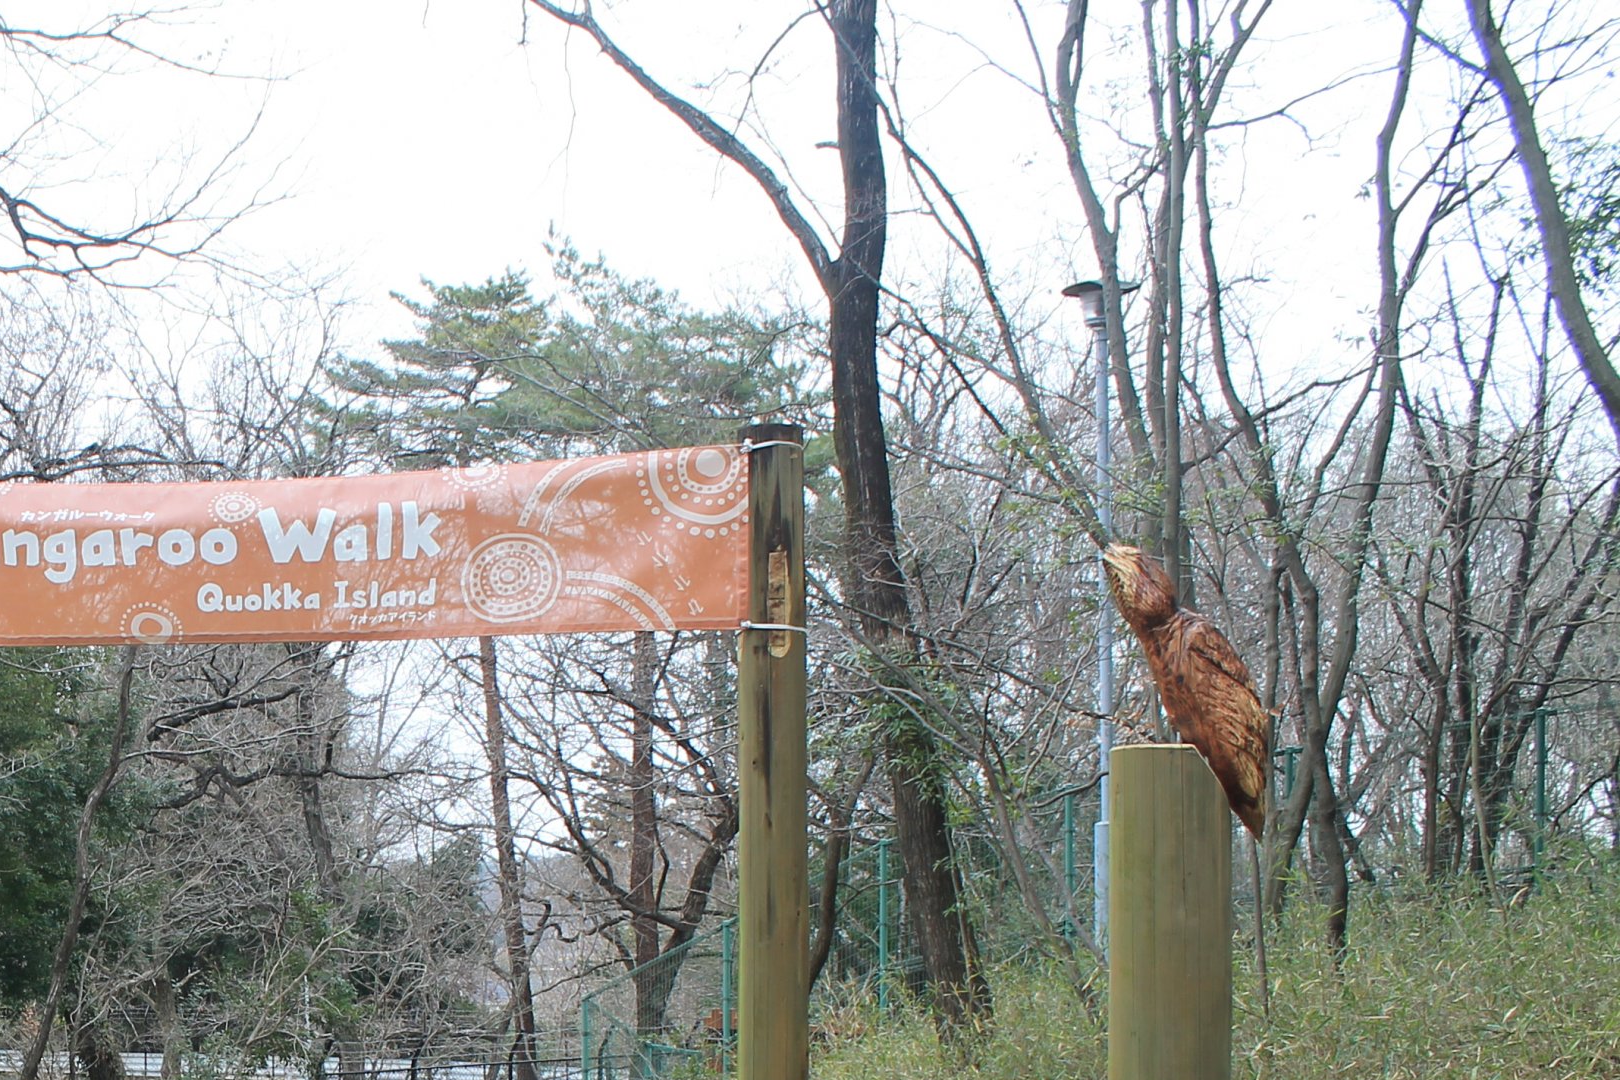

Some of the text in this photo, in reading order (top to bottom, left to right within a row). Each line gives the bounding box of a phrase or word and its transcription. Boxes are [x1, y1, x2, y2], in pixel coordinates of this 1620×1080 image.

[20, 508, 156, 522] カンガルーウォーク
[257, 501, 441, 563] Walk
[197, 578, 437, 612] Quokka Island
[349, 610, 437, 625] クオッカアイランド
